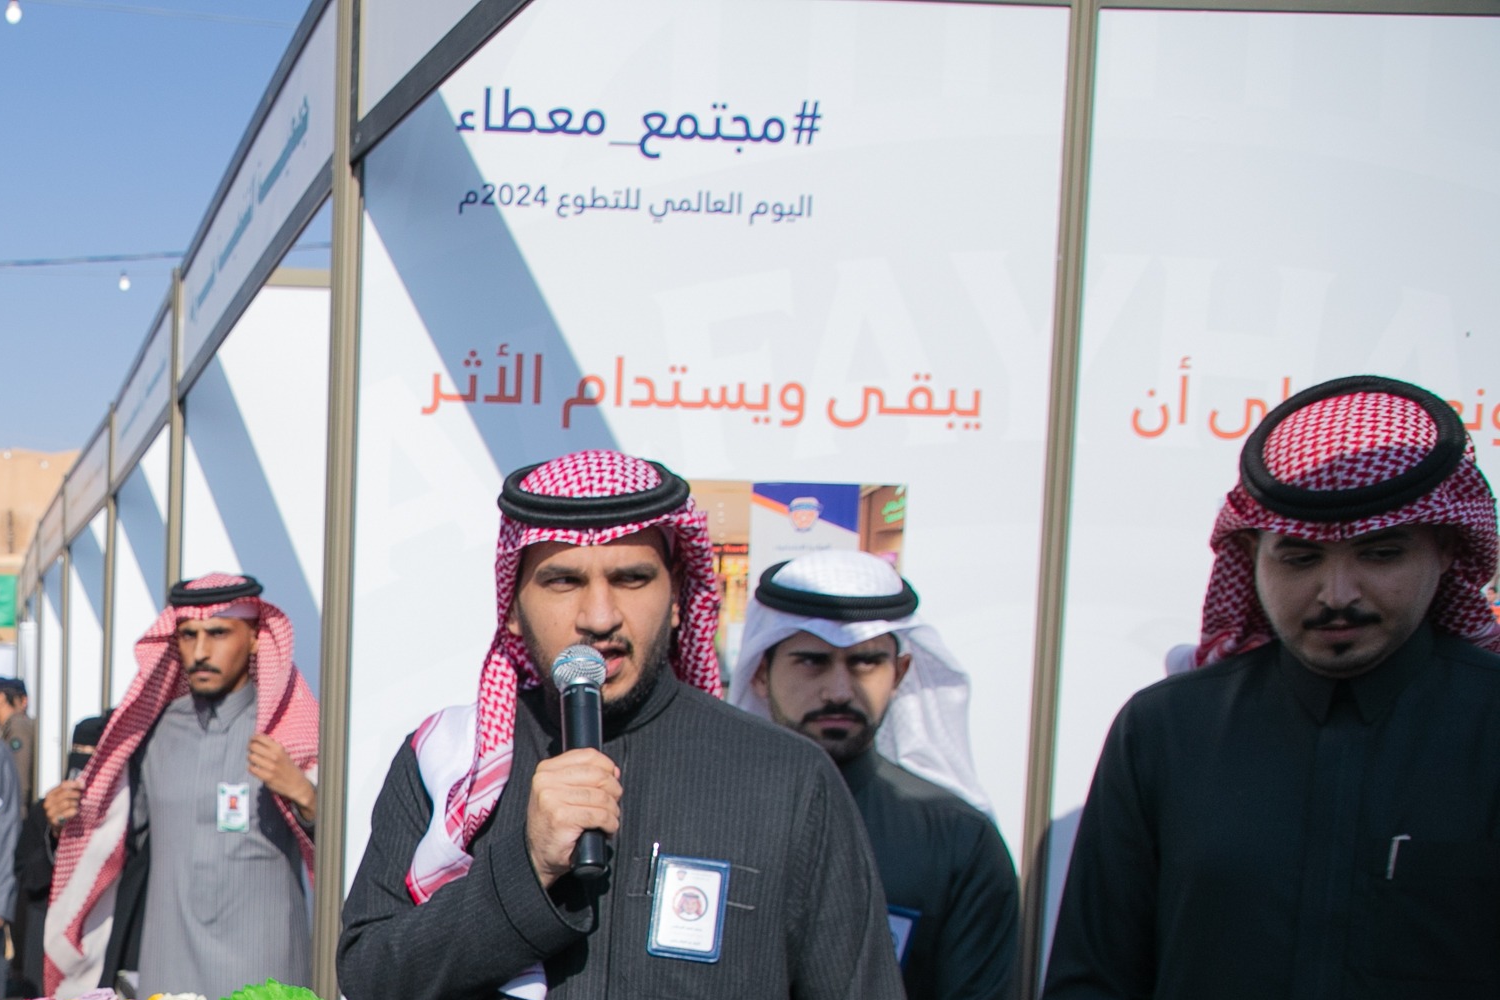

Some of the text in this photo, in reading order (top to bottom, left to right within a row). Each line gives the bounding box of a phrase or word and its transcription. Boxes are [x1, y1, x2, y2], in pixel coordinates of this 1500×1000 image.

[455, 86, 822, 159] #مجتمع_معطاء
[458, 182, 814, 226] اليوم العالمي للتطوع 2024م
[420, 342, 544, 416] الأثر
[562, 354, 807, 431] ويستدام
[1131, 356, 1191, 439] أن
